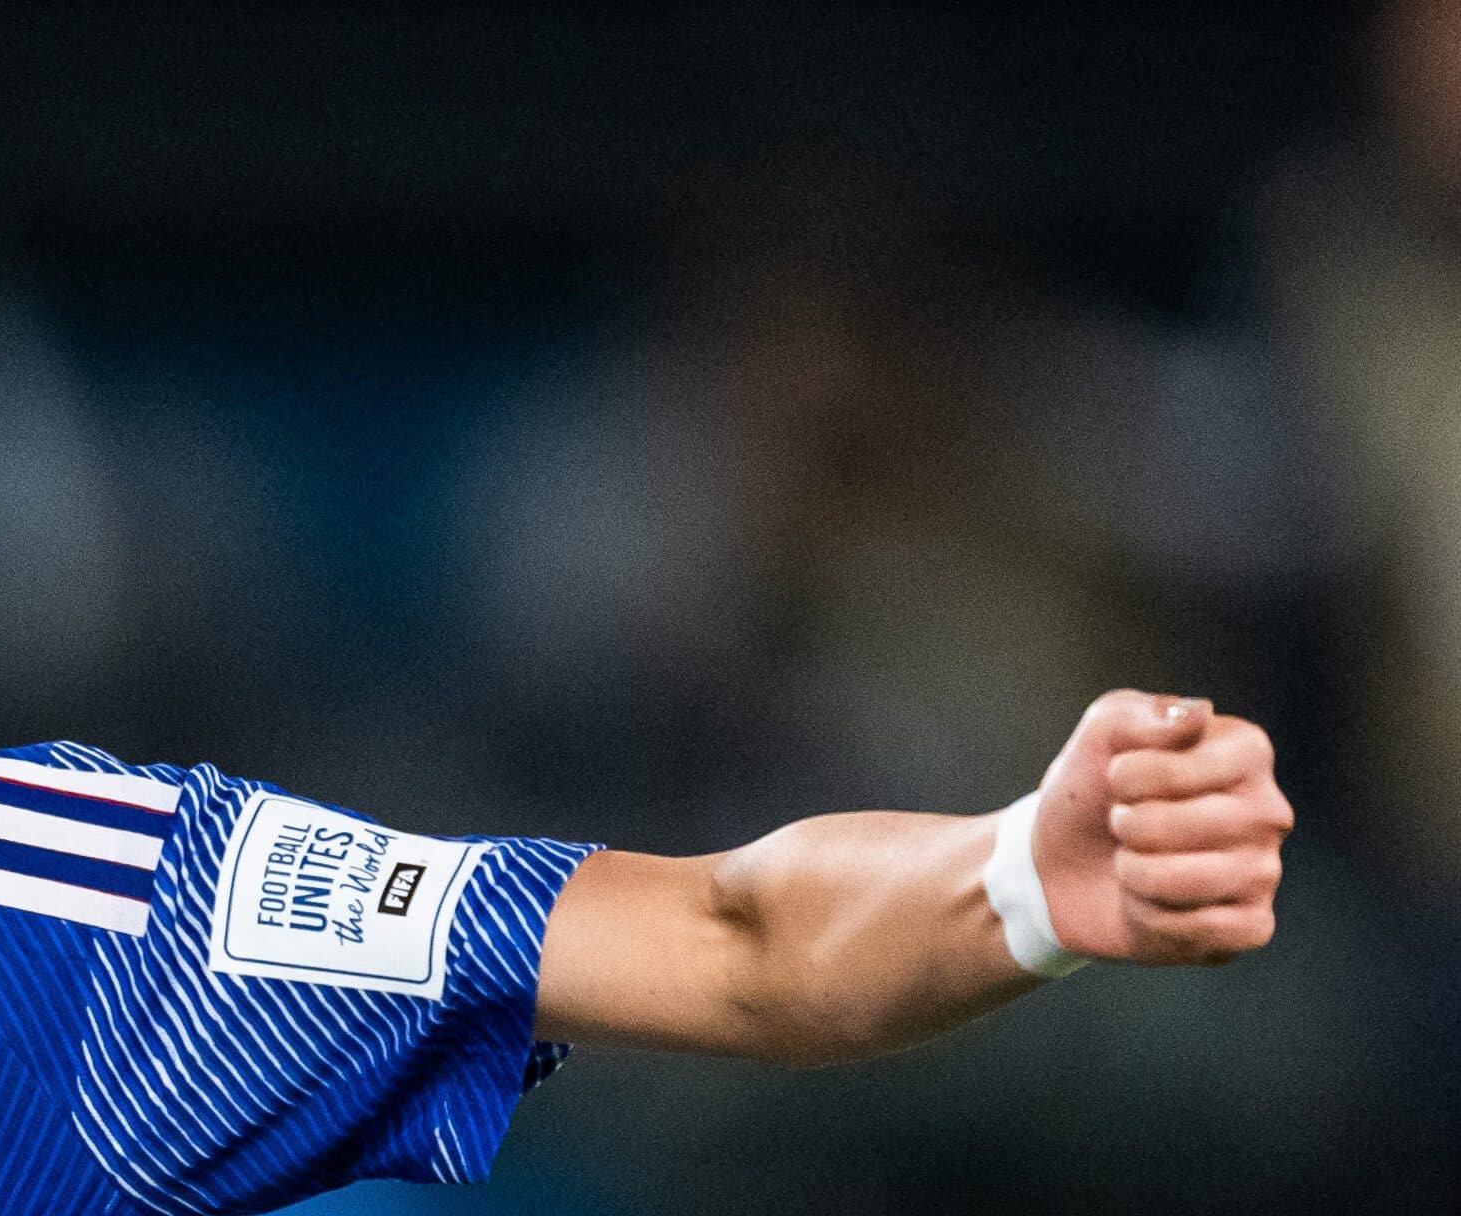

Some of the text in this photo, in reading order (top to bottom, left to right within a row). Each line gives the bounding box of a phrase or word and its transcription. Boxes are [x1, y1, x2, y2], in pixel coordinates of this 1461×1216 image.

[257, 824, 312, 927] FOOTBALL
[290, 827, 354, 933] UNITES
[331, 828, 398, 946] the World
[384, 867, 420, 910] FIFA
